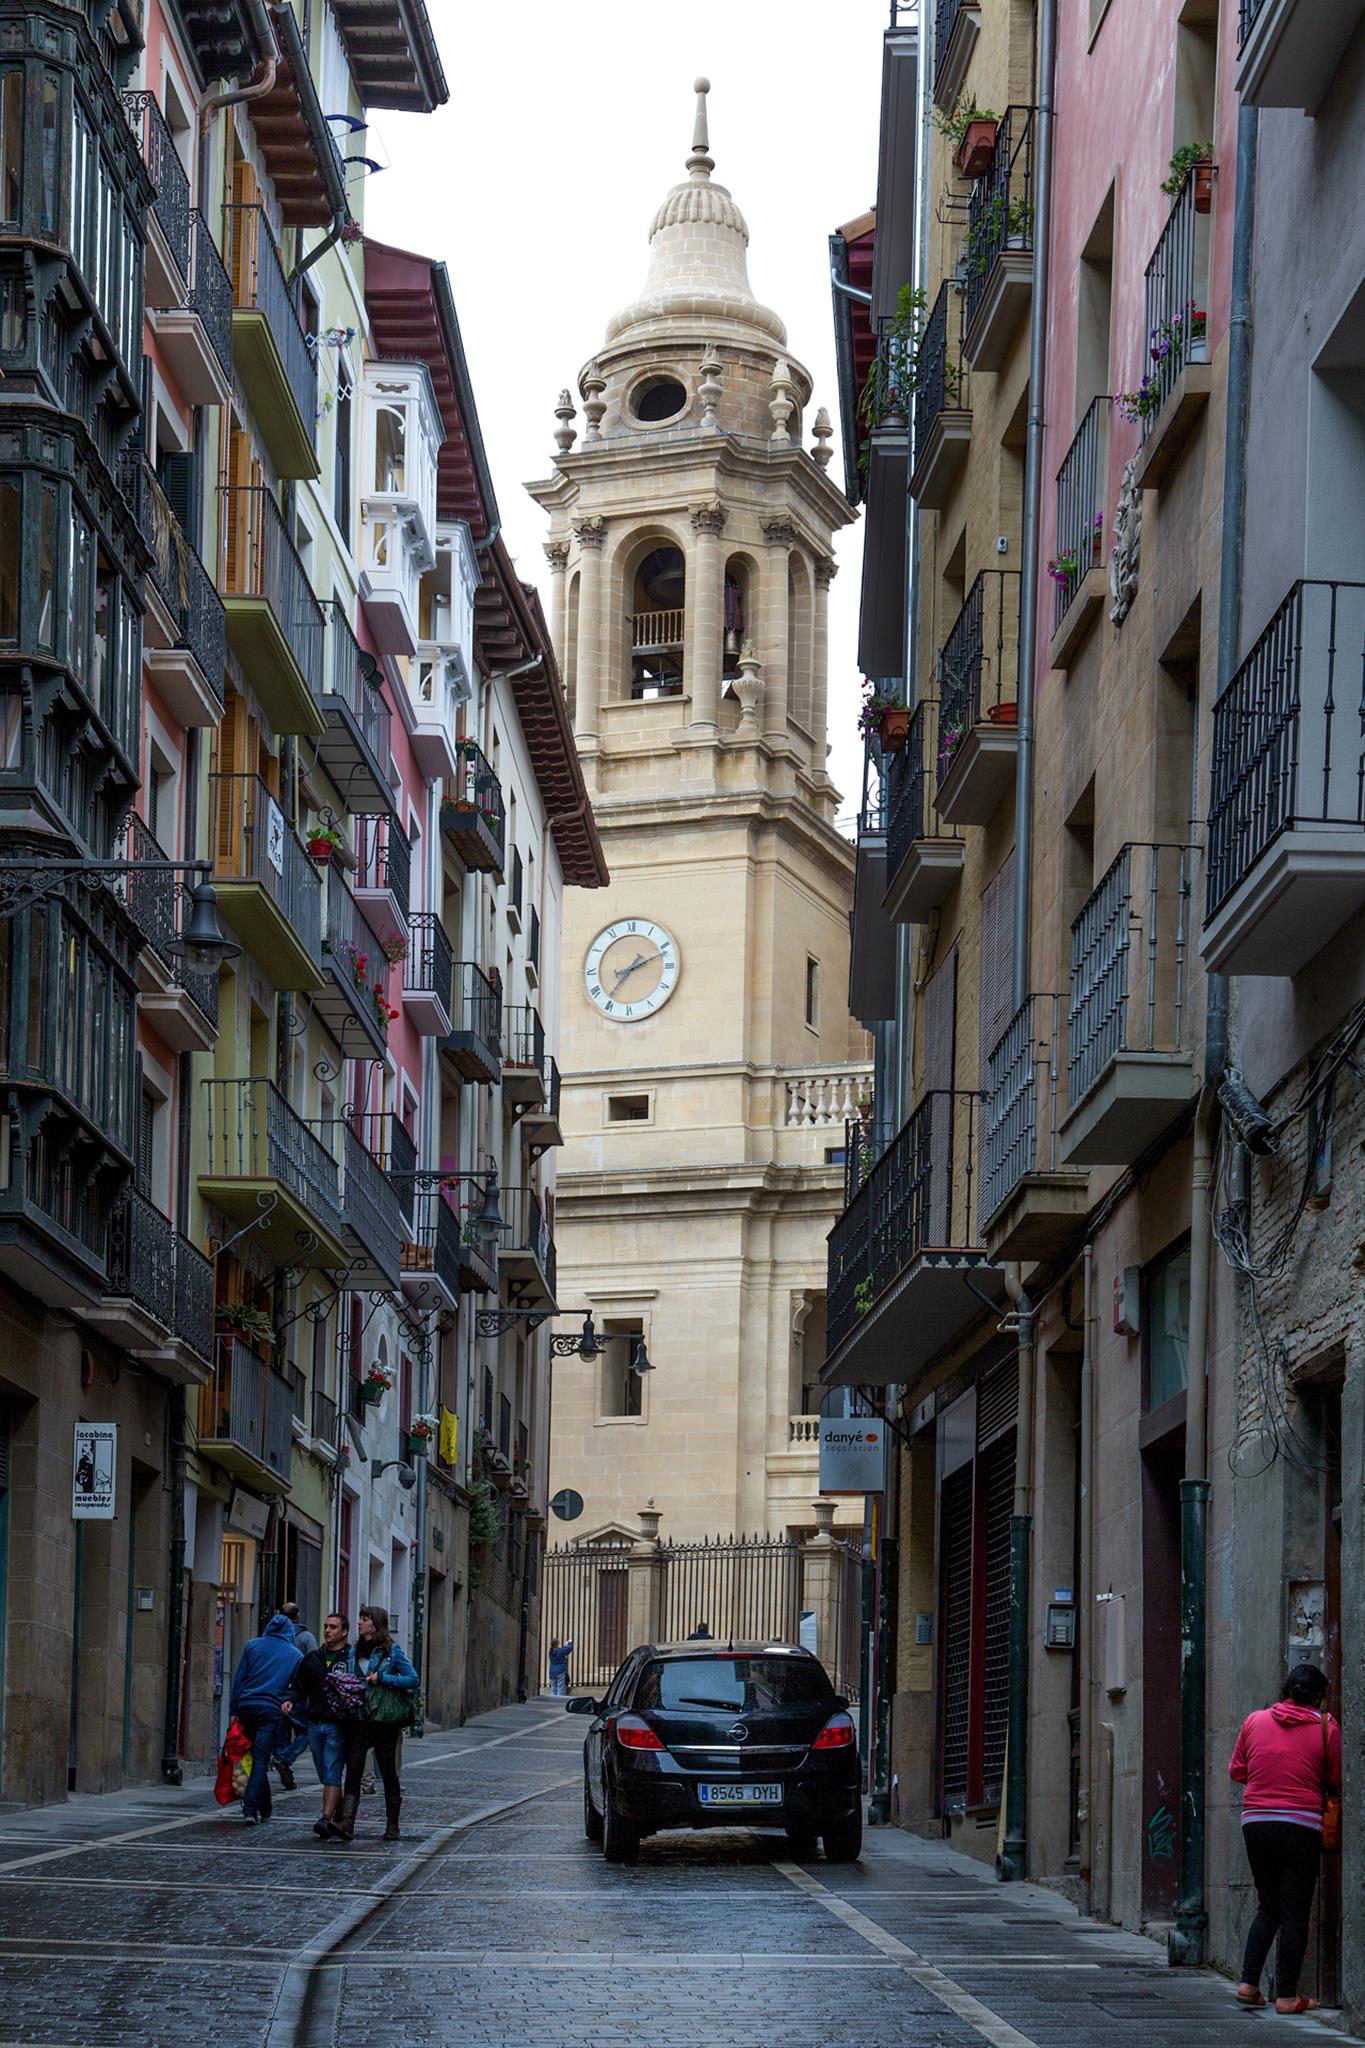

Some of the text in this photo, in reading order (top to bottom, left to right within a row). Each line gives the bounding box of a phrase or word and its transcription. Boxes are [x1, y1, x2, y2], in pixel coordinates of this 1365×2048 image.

[824, 1430, 863, 1445] danyé
[74, 1494, 111, 1502] muebles
[710, 1786, 778, 1800] 8545 DYH
